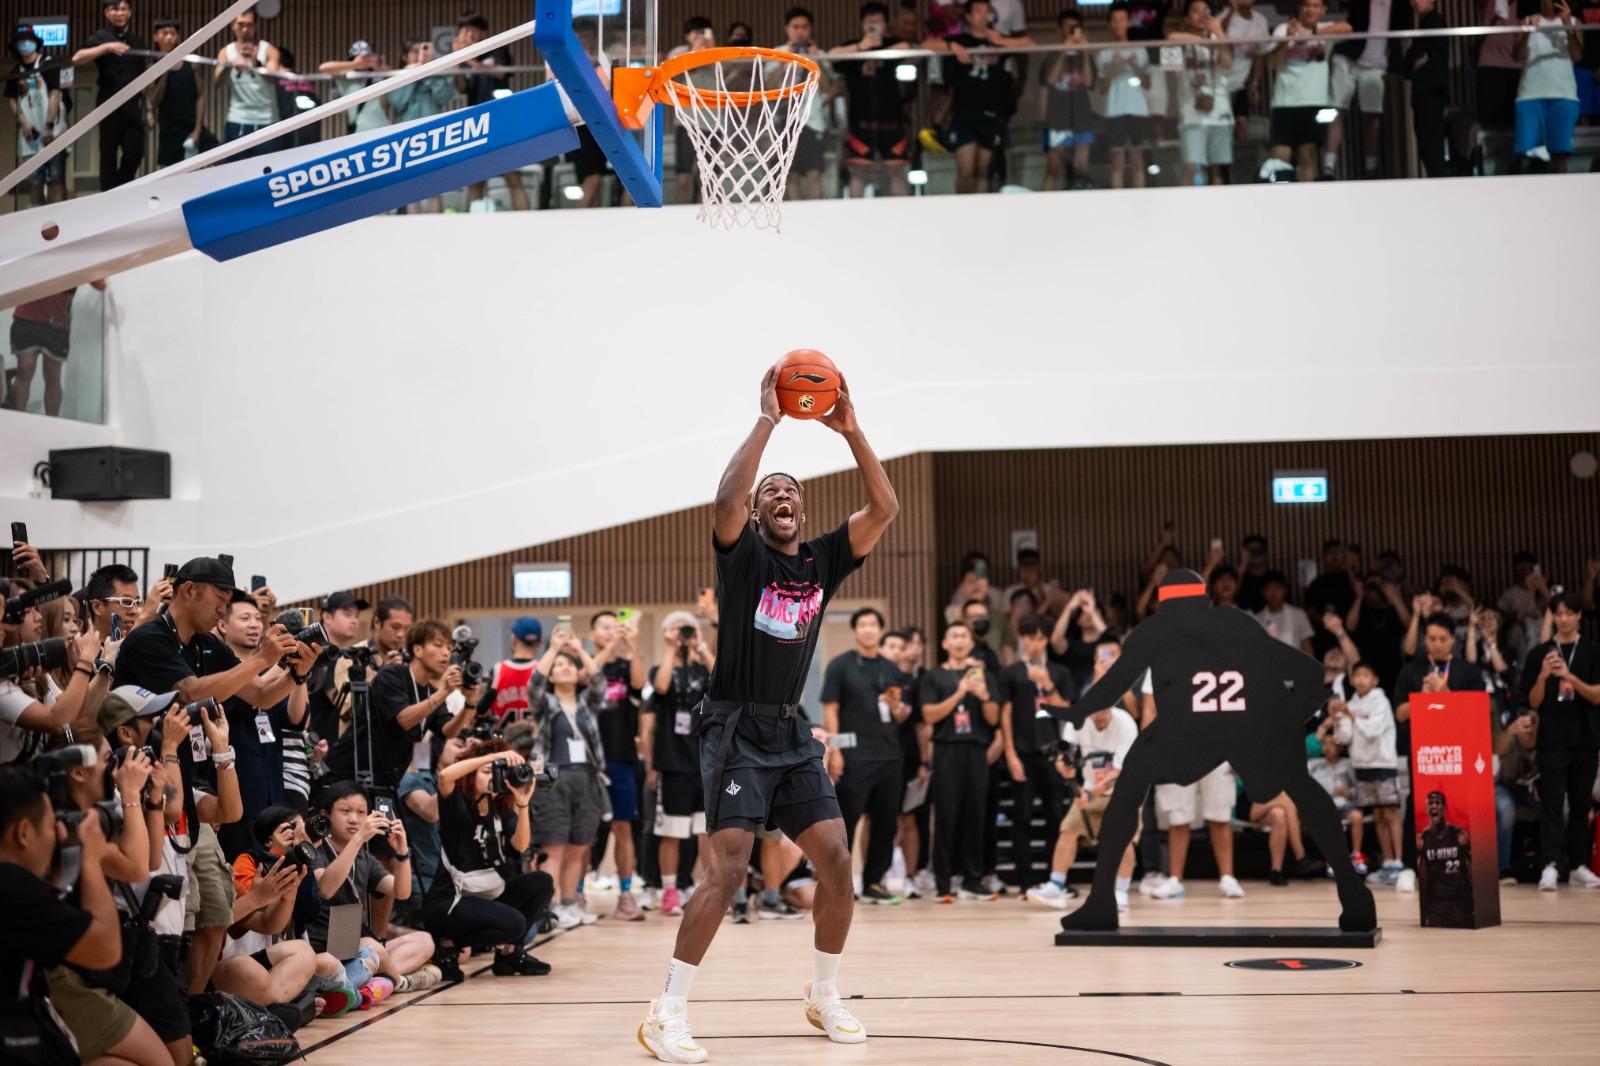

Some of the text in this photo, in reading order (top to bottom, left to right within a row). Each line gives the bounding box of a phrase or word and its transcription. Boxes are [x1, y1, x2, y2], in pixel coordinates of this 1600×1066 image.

[268, 112, 490, 199] SPORT SYSTEM
[1192, 670, 1247, 713] 22
[1445, 860, 1461, 875] 22
